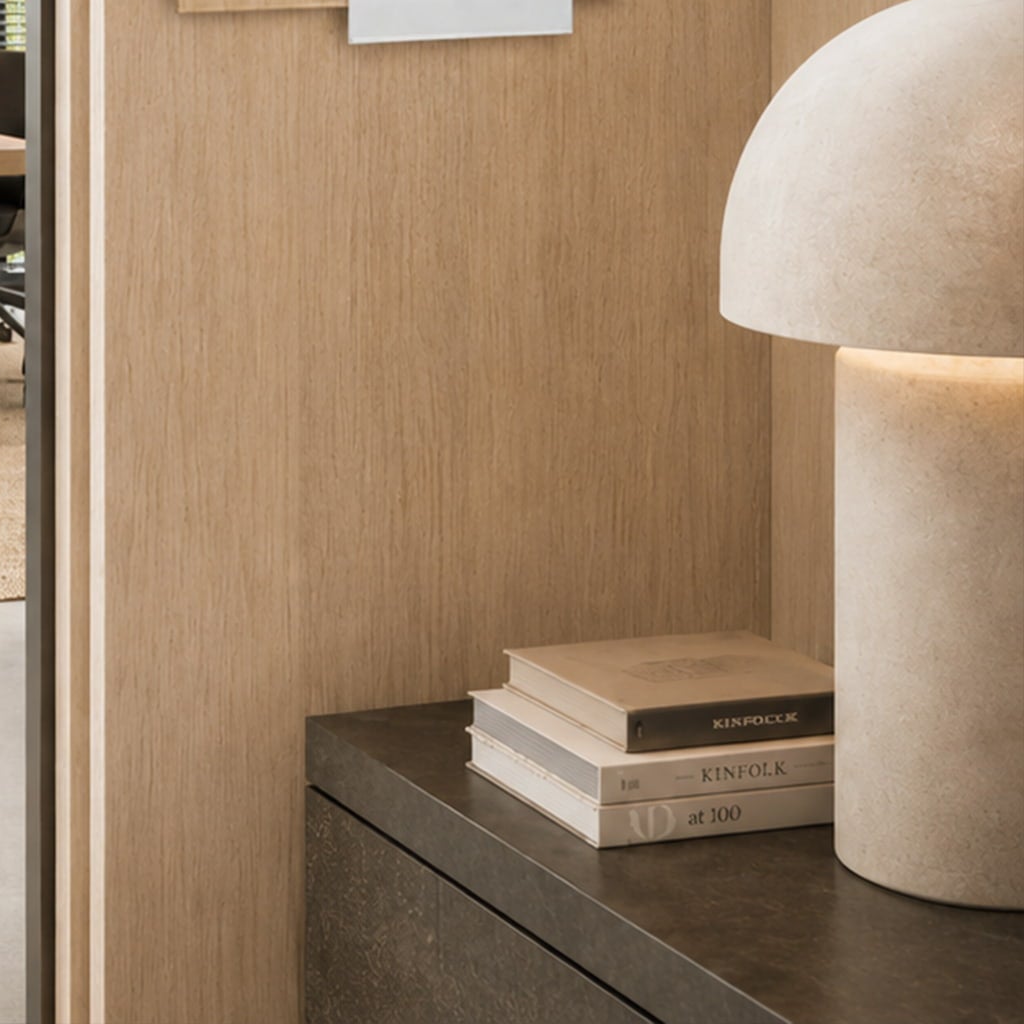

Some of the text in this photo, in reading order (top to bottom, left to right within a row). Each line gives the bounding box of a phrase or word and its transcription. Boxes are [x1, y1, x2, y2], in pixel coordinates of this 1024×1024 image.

[701, 761, 787, 782] KINFOLK
[688, 810, 705, 826] at
[711, 804, 742, 824] 100
